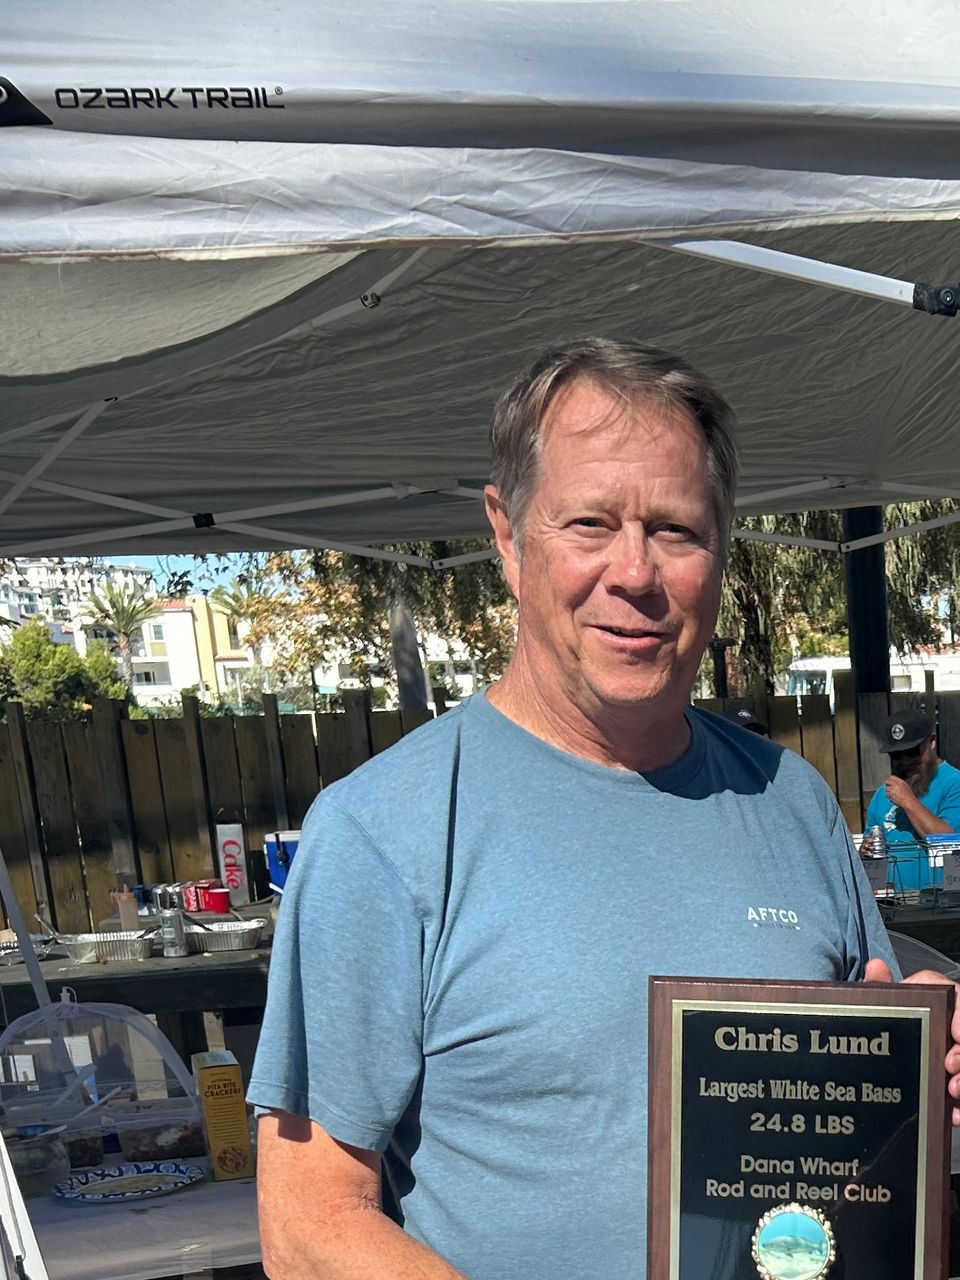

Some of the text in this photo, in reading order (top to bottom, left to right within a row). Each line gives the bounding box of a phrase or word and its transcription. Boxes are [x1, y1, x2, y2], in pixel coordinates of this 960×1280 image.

[55, 87, 179, 109] OZARK
[747, 906, 799, 924] AFTCO
[714, 1026, 891, 1056] Chris Lund
[699, 1076, 902, 1104] Largest White Sea Bass
[750, 1112, 856, 1135] 24.8 LBS
[740, 1154, 860, 1177] Dana Wharf
[706, 1179, 892, 1204] Rod and Reel Club
